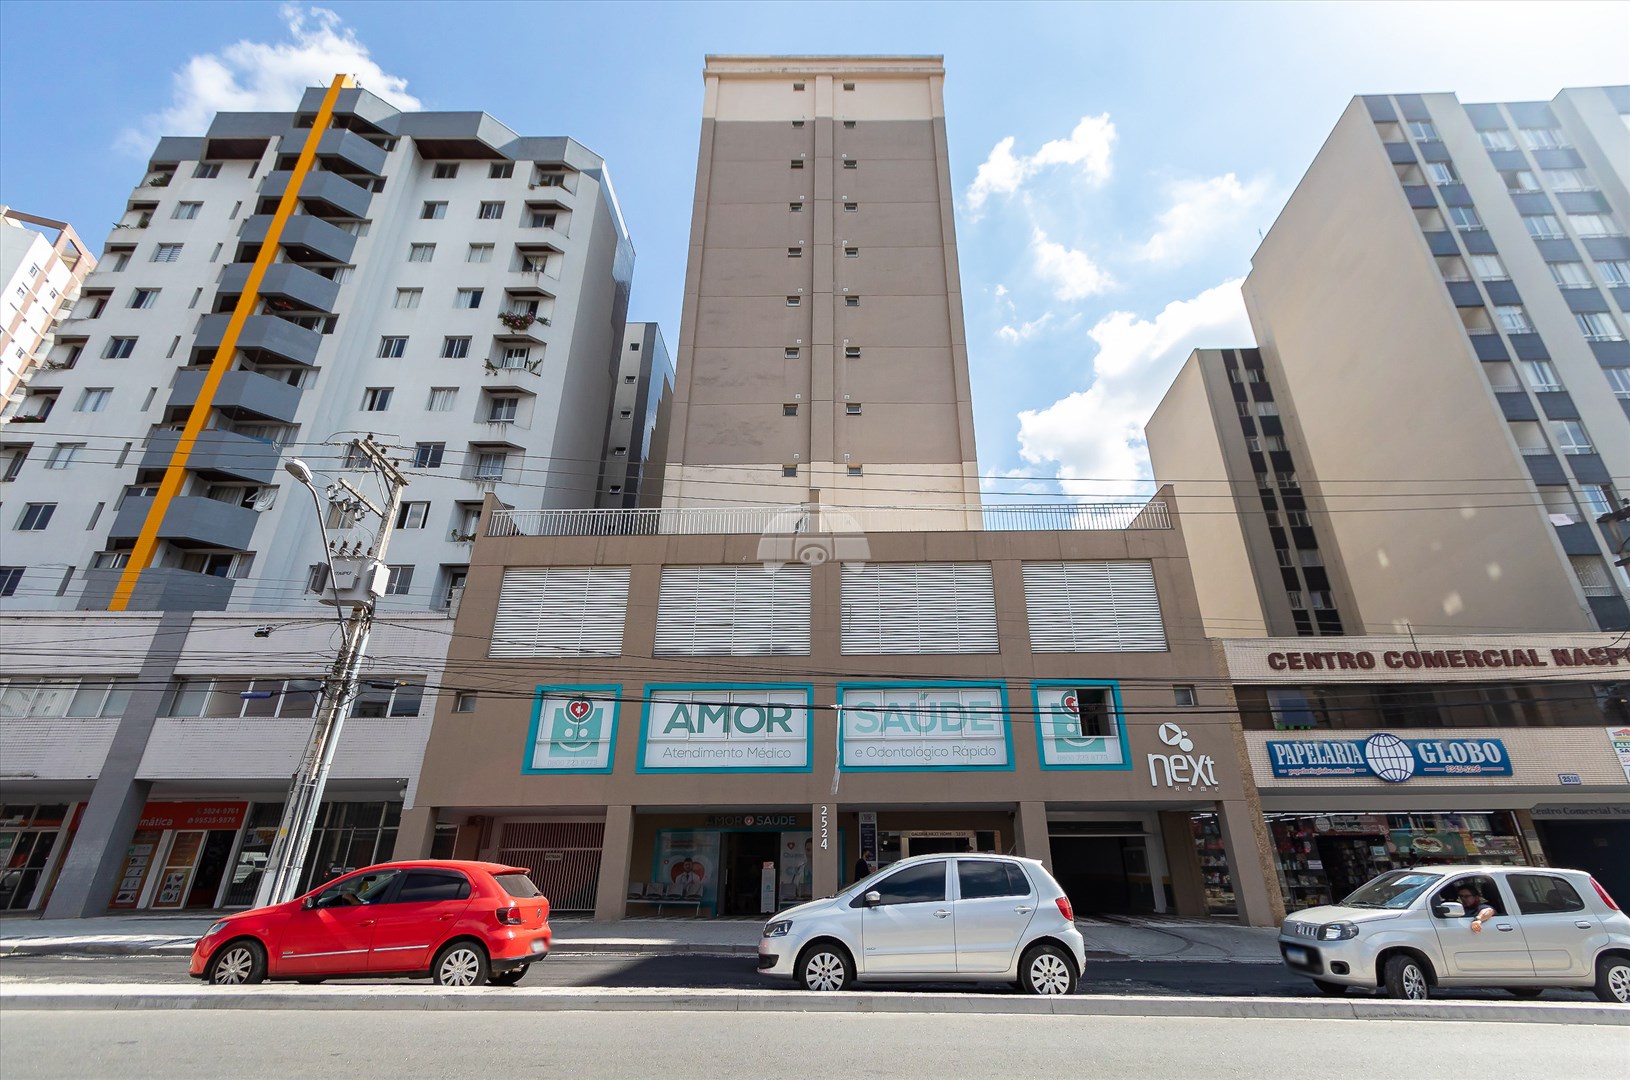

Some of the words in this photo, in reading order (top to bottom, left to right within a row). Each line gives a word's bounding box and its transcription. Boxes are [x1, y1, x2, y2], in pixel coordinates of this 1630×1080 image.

[1267, 651, 1376, 670] CENTRO
[1383, 648, 1548, 669] COMERCIAL
[1550, 647, 1630, 667] NASP
[663, 702, 793, 734] AMOR
[854, 693, 995, 734] SAÚDE
[662, 746, 744, 759] Atendimento
[747, 746, 792, 759] Médico
[855, 749, 863, 758] e
[866, 746, 949, 761] Odontológico
[952, 745, 996, 759] Rápido
[1273, 743, 1365, 765] PAPELARIA
[1417, 741, 1502, 764] GLOBO
[1147, 753, 1219, 787] next
[705, 815, 742, 825] AMOR
[756, 813, 796, 826] SAÚDE
[1531, 807, 1561, 815] Centro
[1563, 806, 1611, 815] Comercial
[820, 805, 828, 850] 2524
